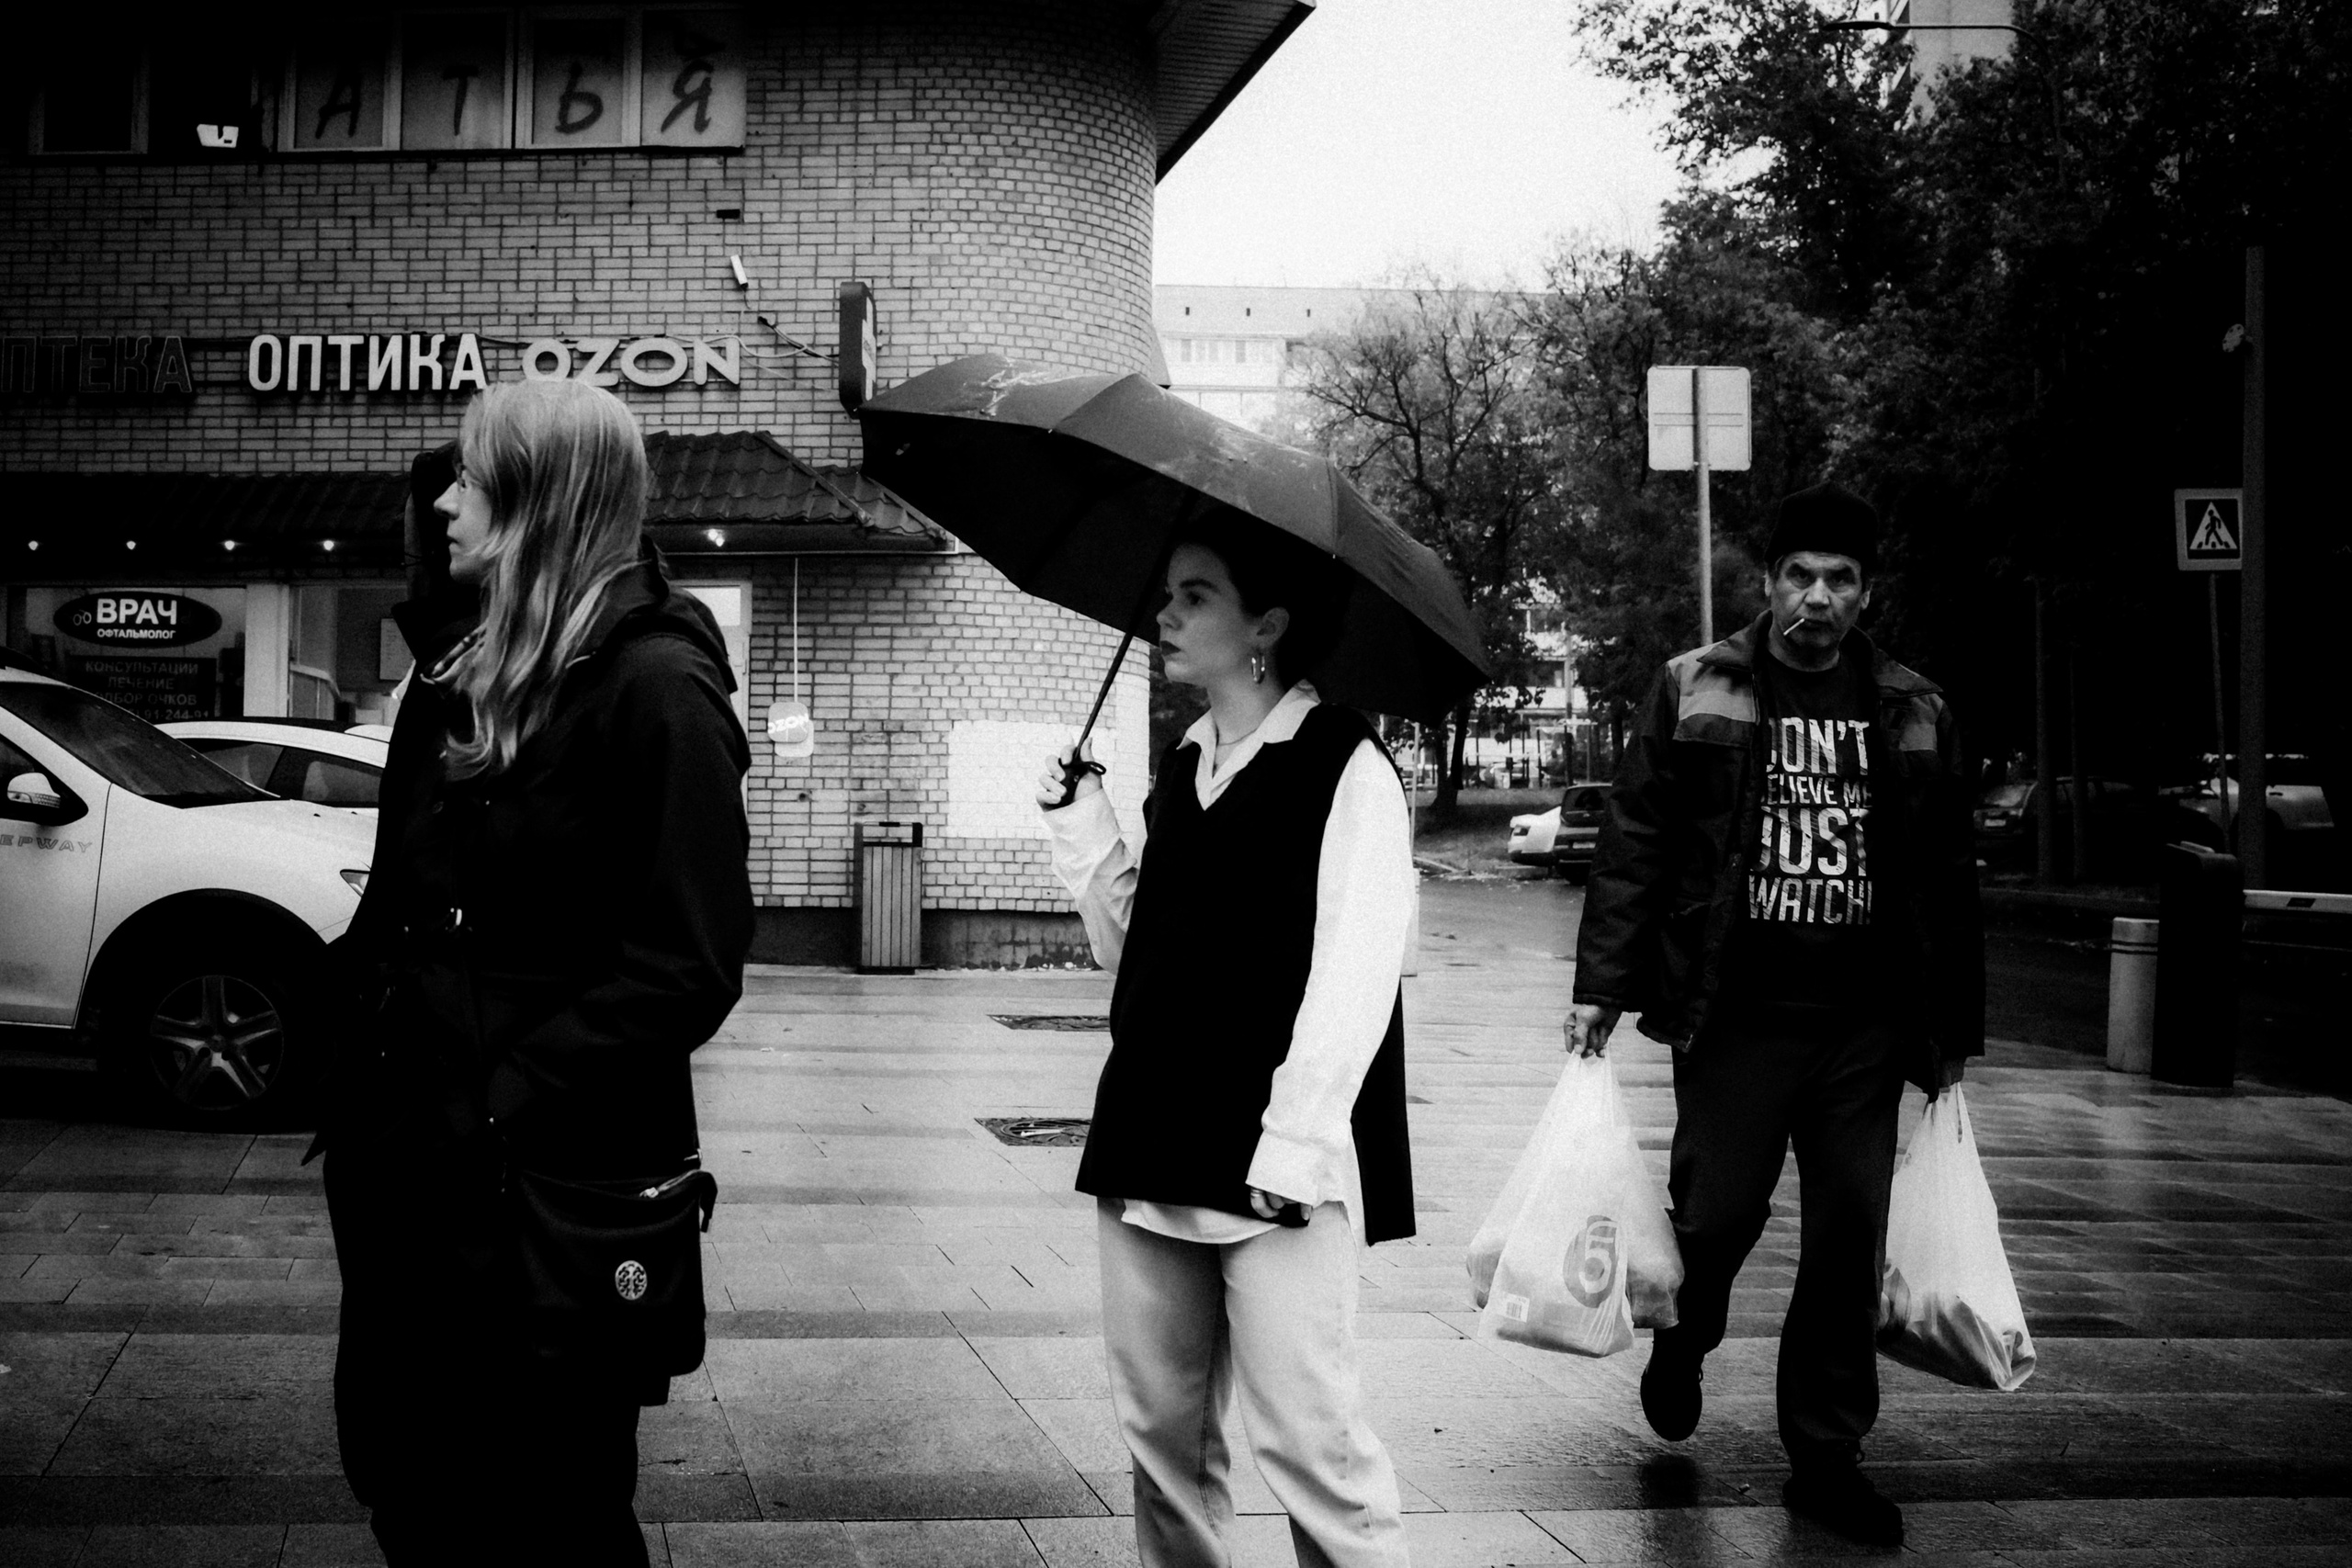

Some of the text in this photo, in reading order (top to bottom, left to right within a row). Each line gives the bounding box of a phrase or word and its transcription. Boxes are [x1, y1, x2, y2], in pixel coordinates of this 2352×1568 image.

[0, 335, 193, 393] ПТЕКА
[248, 333, 487, 391] ОПТИКА
[522, 337, 741, 387] OZON
[96, 598, 177, 625] ВРАЧ
[96, 628, 176, 639] ОФТАЛЬМОЛОГ
[85, 660, 198, 675] КОНСУЛЬТАЦИИ
[107, 676, 175, 690] ЛЕЧЕНИЕ
[96, 692, 198, 705] ДБОР ОЧКОВ
[1760, 773, 1874, 808] ELIEVE ME
[0, 834, 93, 853] EPWAY
[1750, 806, 1871, 877] JUST
[1748, 874, 1873, 926] WATCH!
